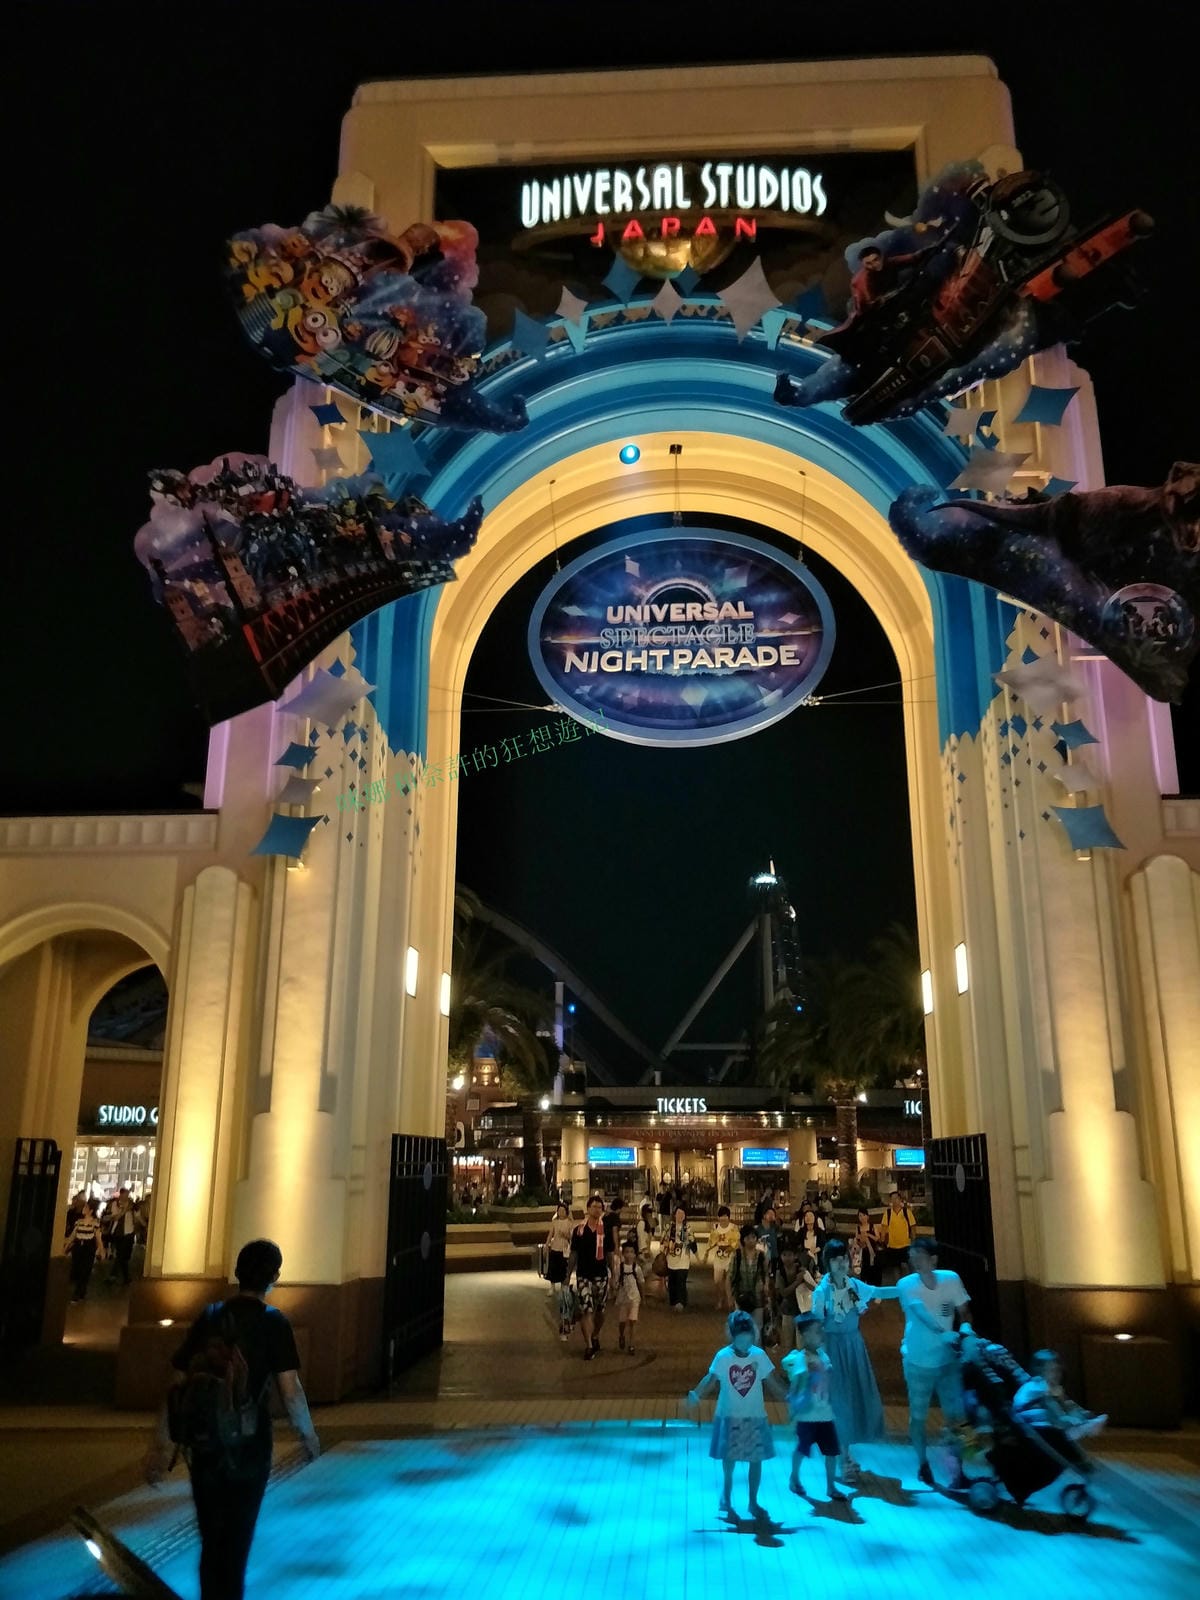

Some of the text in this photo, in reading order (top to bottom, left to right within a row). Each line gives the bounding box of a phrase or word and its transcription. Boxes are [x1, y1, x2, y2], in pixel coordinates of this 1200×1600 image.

[521, 161, 828, 229] UNIVERSAL STUDIOS
[590, 215, 757, 248] JAPAN
[606, 601, 754, 625] UNIVERSAL
[599, 622, 757, 650] SPECTACLE
[563, 644, 801, 673] NIGHT PARADE
[99, 1104, 146, 1124] STUDIO
[657, 1097, 707, 1113] TICKETS
